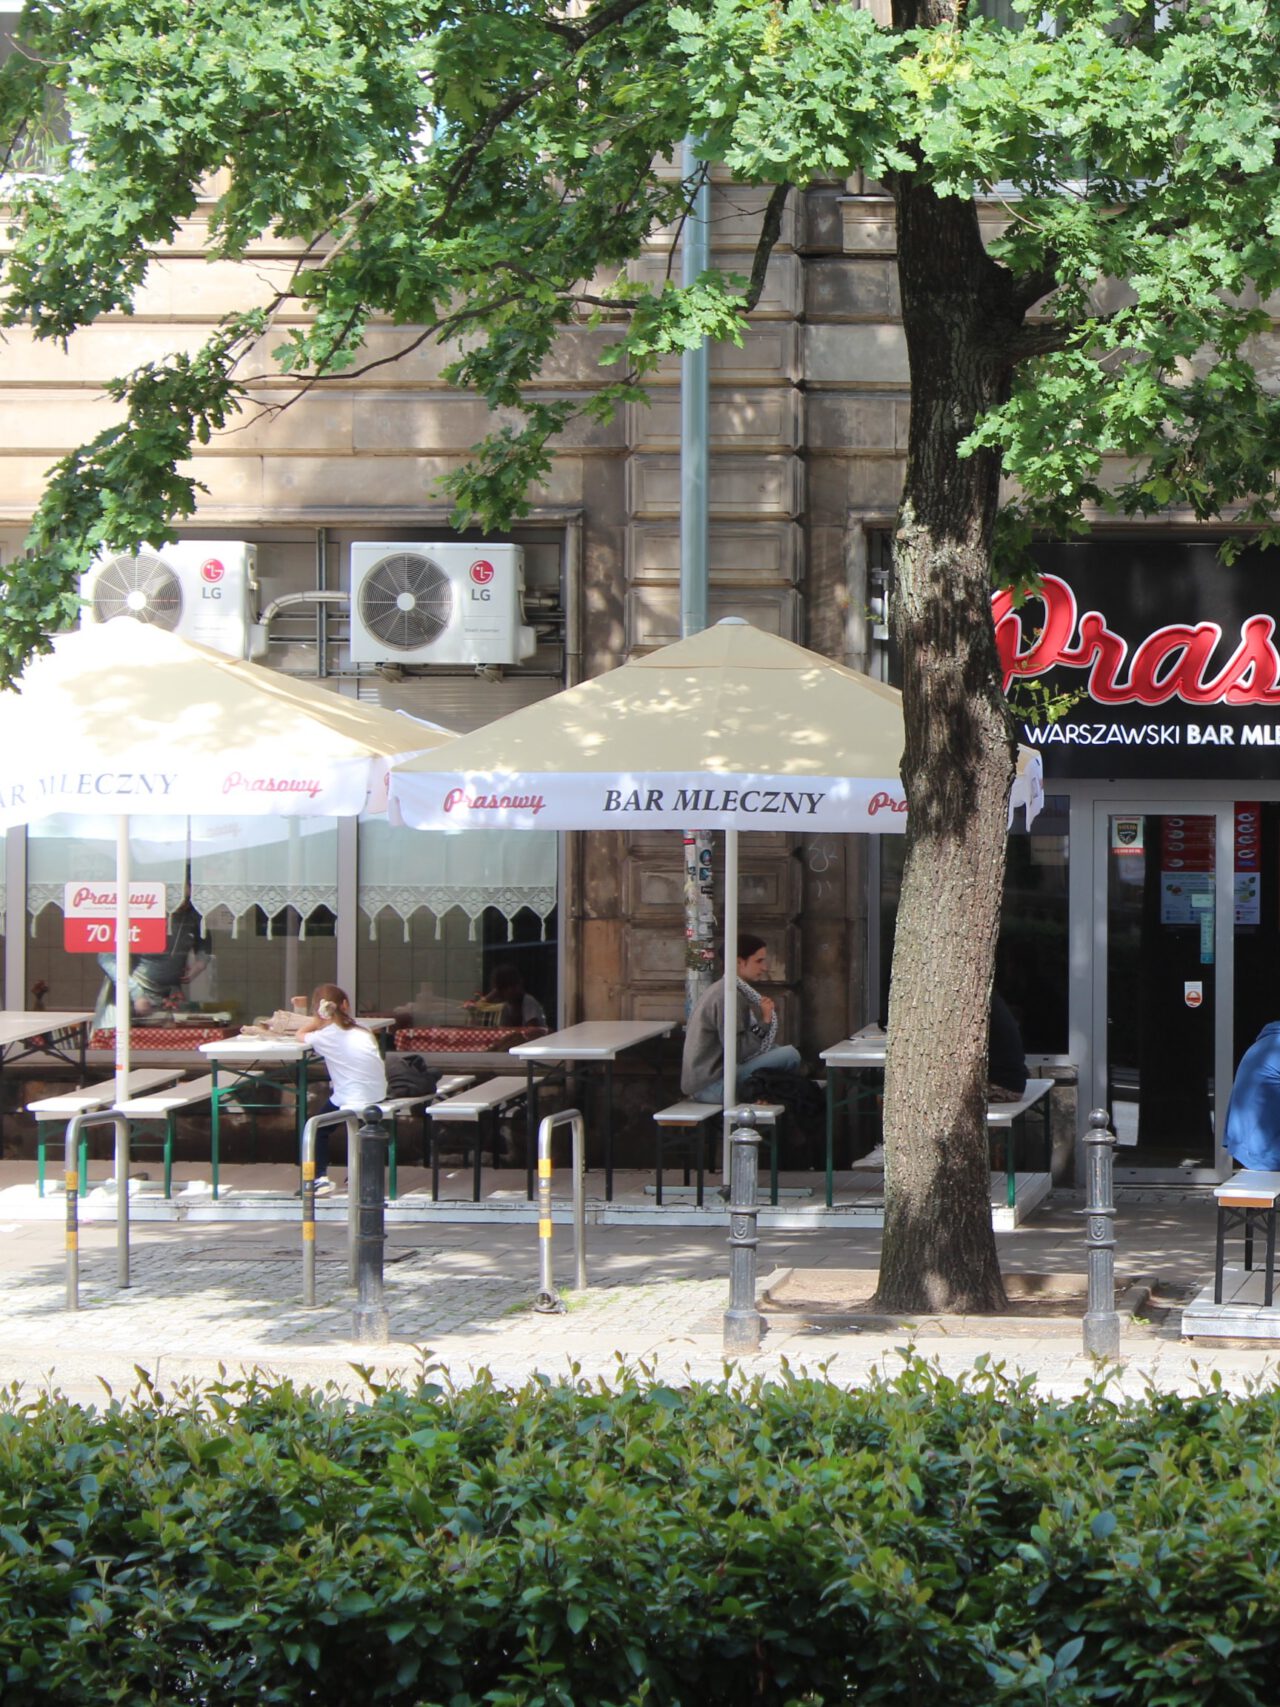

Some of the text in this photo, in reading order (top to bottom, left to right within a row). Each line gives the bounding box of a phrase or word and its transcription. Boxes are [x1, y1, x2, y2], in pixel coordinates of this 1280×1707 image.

[202, 587, 222, 599] LG
[471, 589, 491, 601] LG
[1024, 725, 1180, 744] WARSZAWSKI
[1187, 725, 1235, 745] BAR
[38, 773, 178, 796] MLECZNY
[222, 771, 323, 798] Prasowy
[443, 787, 546, 815] Prasowy
[602, 789, 826, 814] BAR MLECZNY
[73, 887, 158, 909] Praswy
[87, 925, 110, 942] 70
